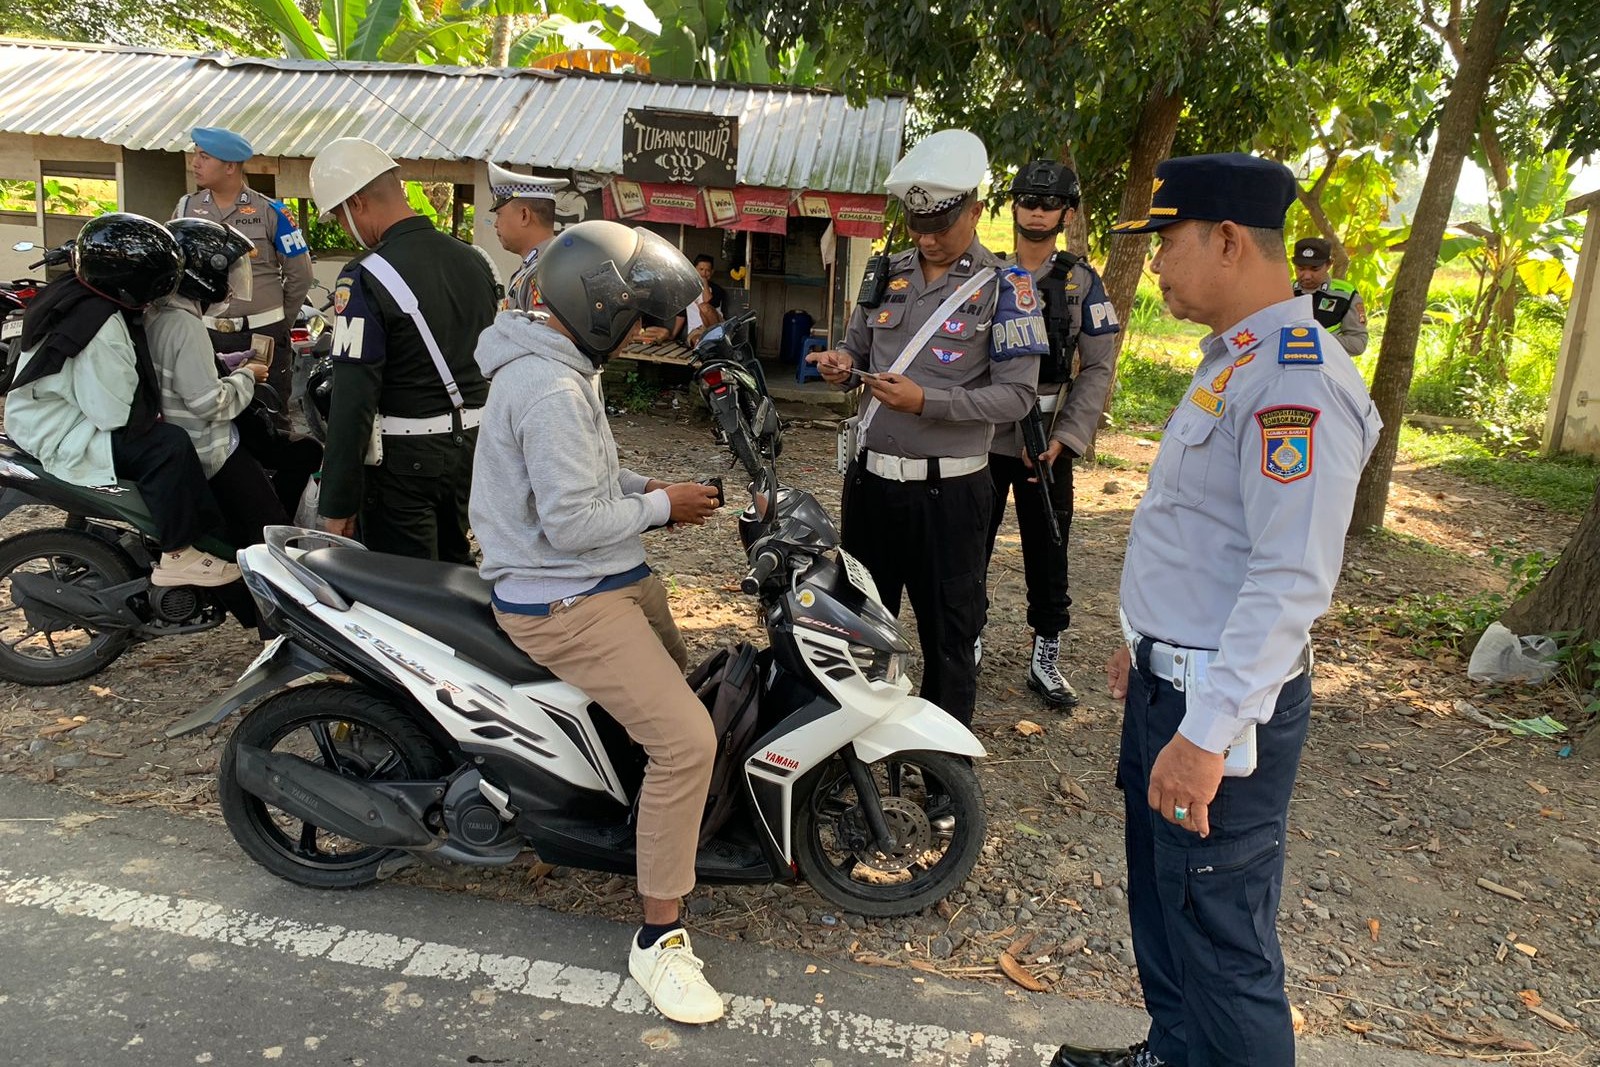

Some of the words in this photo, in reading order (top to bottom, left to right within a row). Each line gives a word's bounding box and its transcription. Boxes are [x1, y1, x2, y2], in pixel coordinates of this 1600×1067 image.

[633, 122, 686, 154] TUKANG
[687, 127, 731, 161] CUKUR
[652, 198, 685, 207] KEMASAN
[743, 207, 777, 215] KEMASAN
[235, 218, 262, 226] POLRI
[765, 751, 800, 770] YAMAHA
